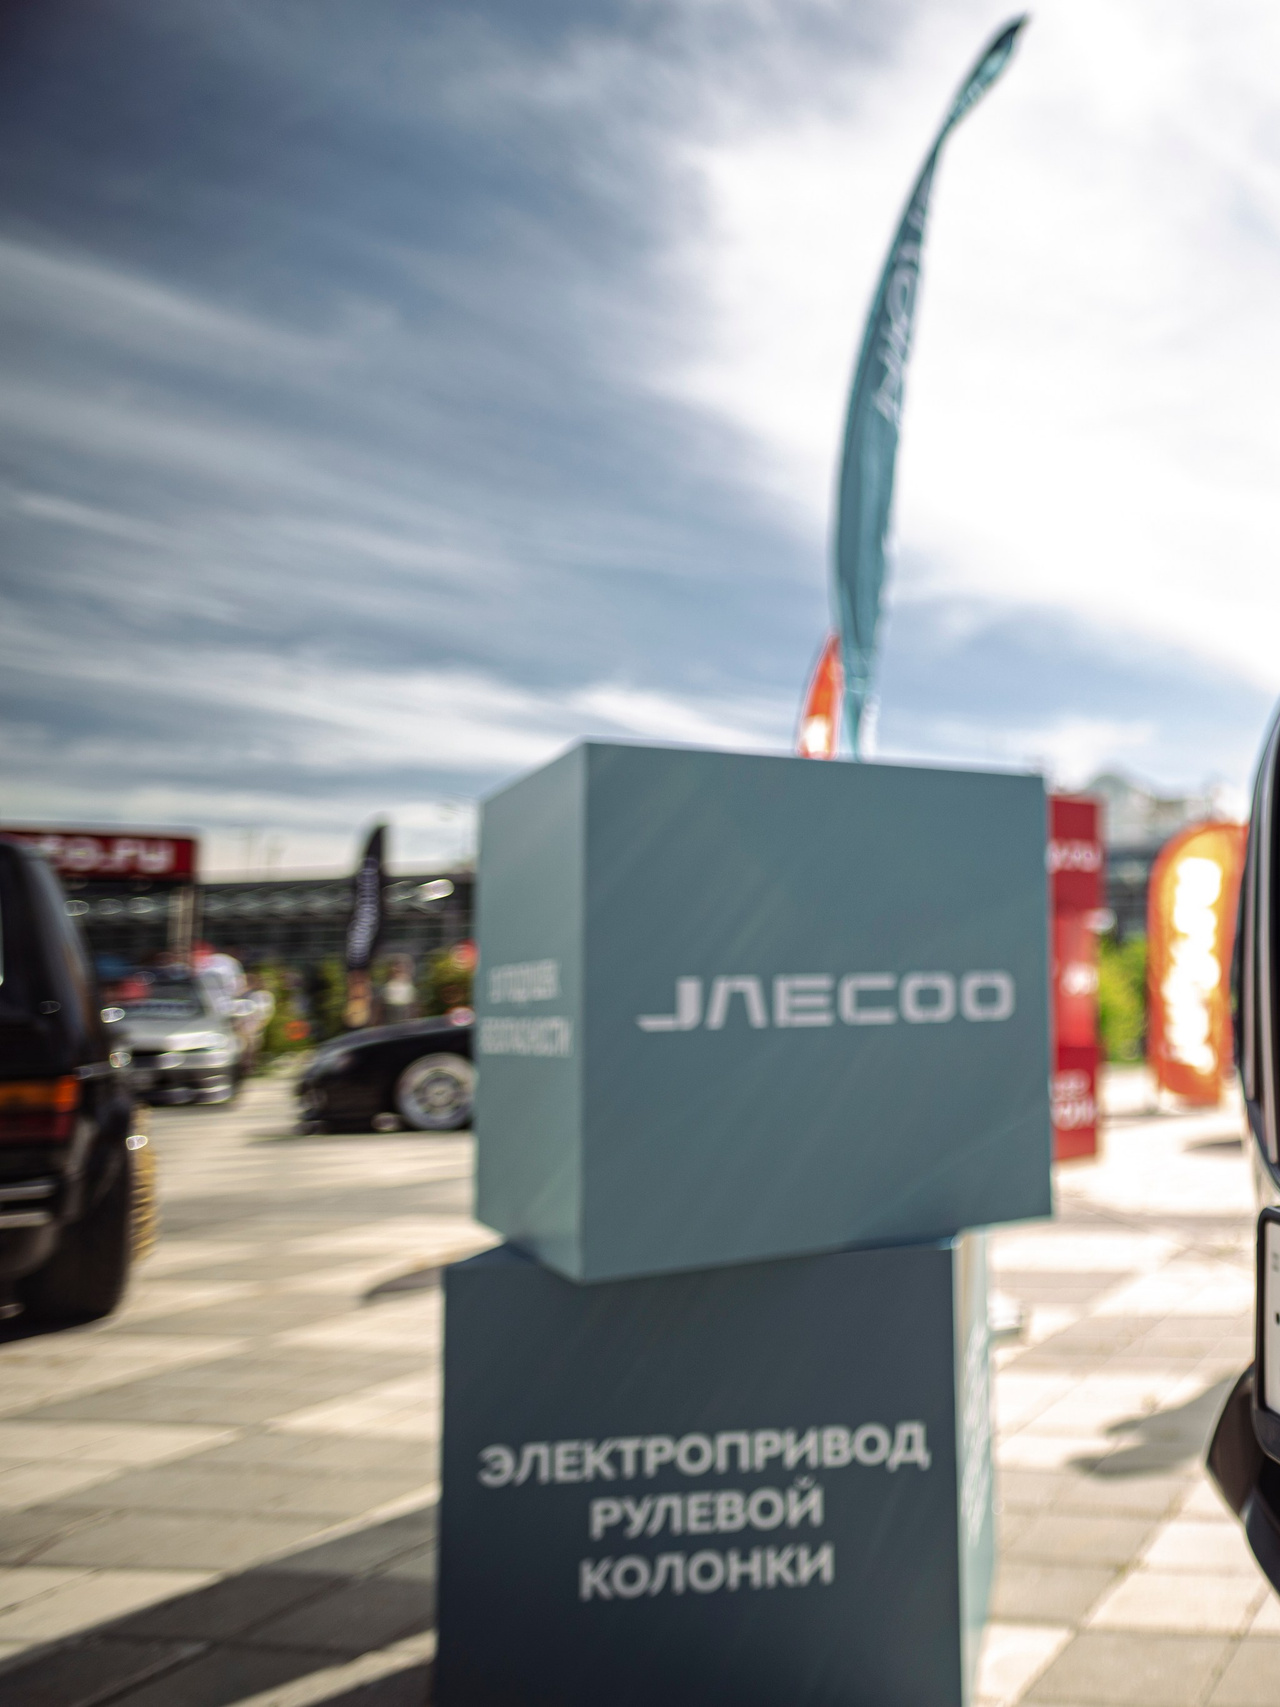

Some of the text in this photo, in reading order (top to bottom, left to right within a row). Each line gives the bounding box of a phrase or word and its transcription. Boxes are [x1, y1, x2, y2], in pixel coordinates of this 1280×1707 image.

[636, 970, 1016, 1032] JAECOO
[479, 1420, 930, 1487] ЭЛЕКТРОПРИВОД
[589, 1476, 824, 1540] РУЛЕВОЙ
[579, 1543, 835, 1600] КОЛОНКИ
